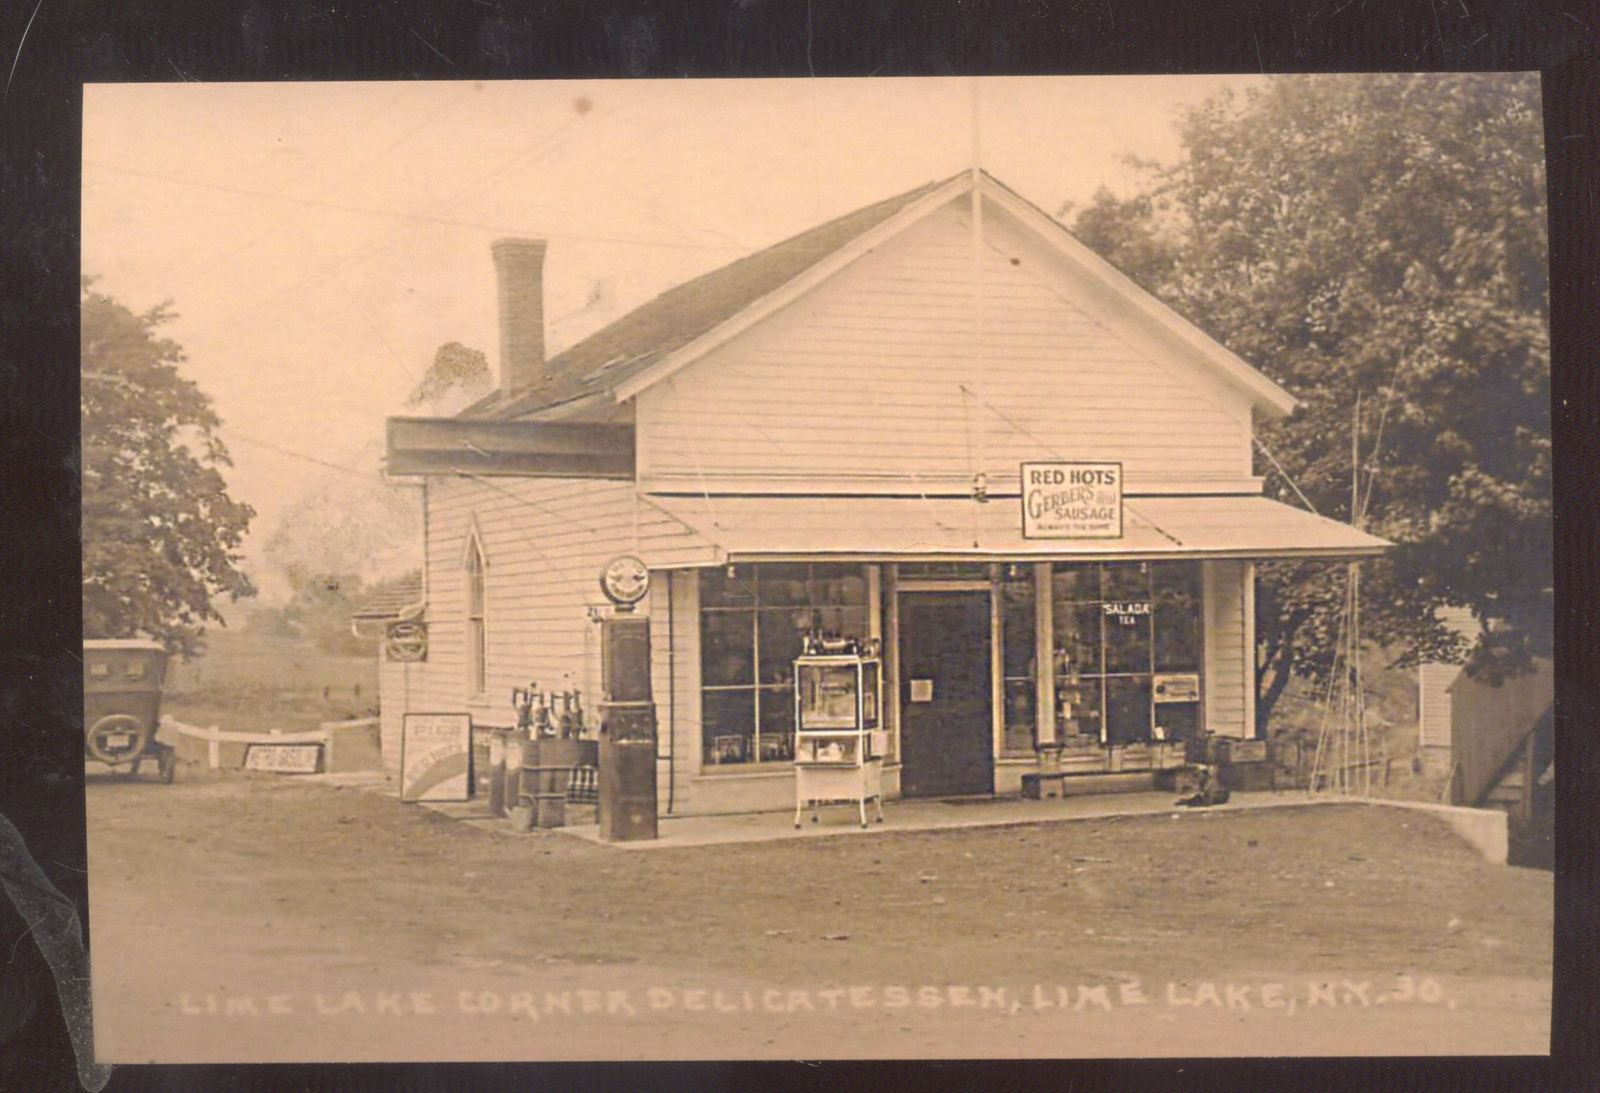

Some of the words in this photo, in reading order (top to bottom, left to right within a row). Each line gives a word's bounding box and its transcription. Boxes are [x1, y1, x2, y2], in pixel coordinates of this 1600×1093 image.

[1030, 470, 1065, 485] RED
[1070, 469, 1115, 485] HOTS
[1055, 507, 1115, 520] SAUSAGE
[1102, 603, 1150, 614] SALADA
